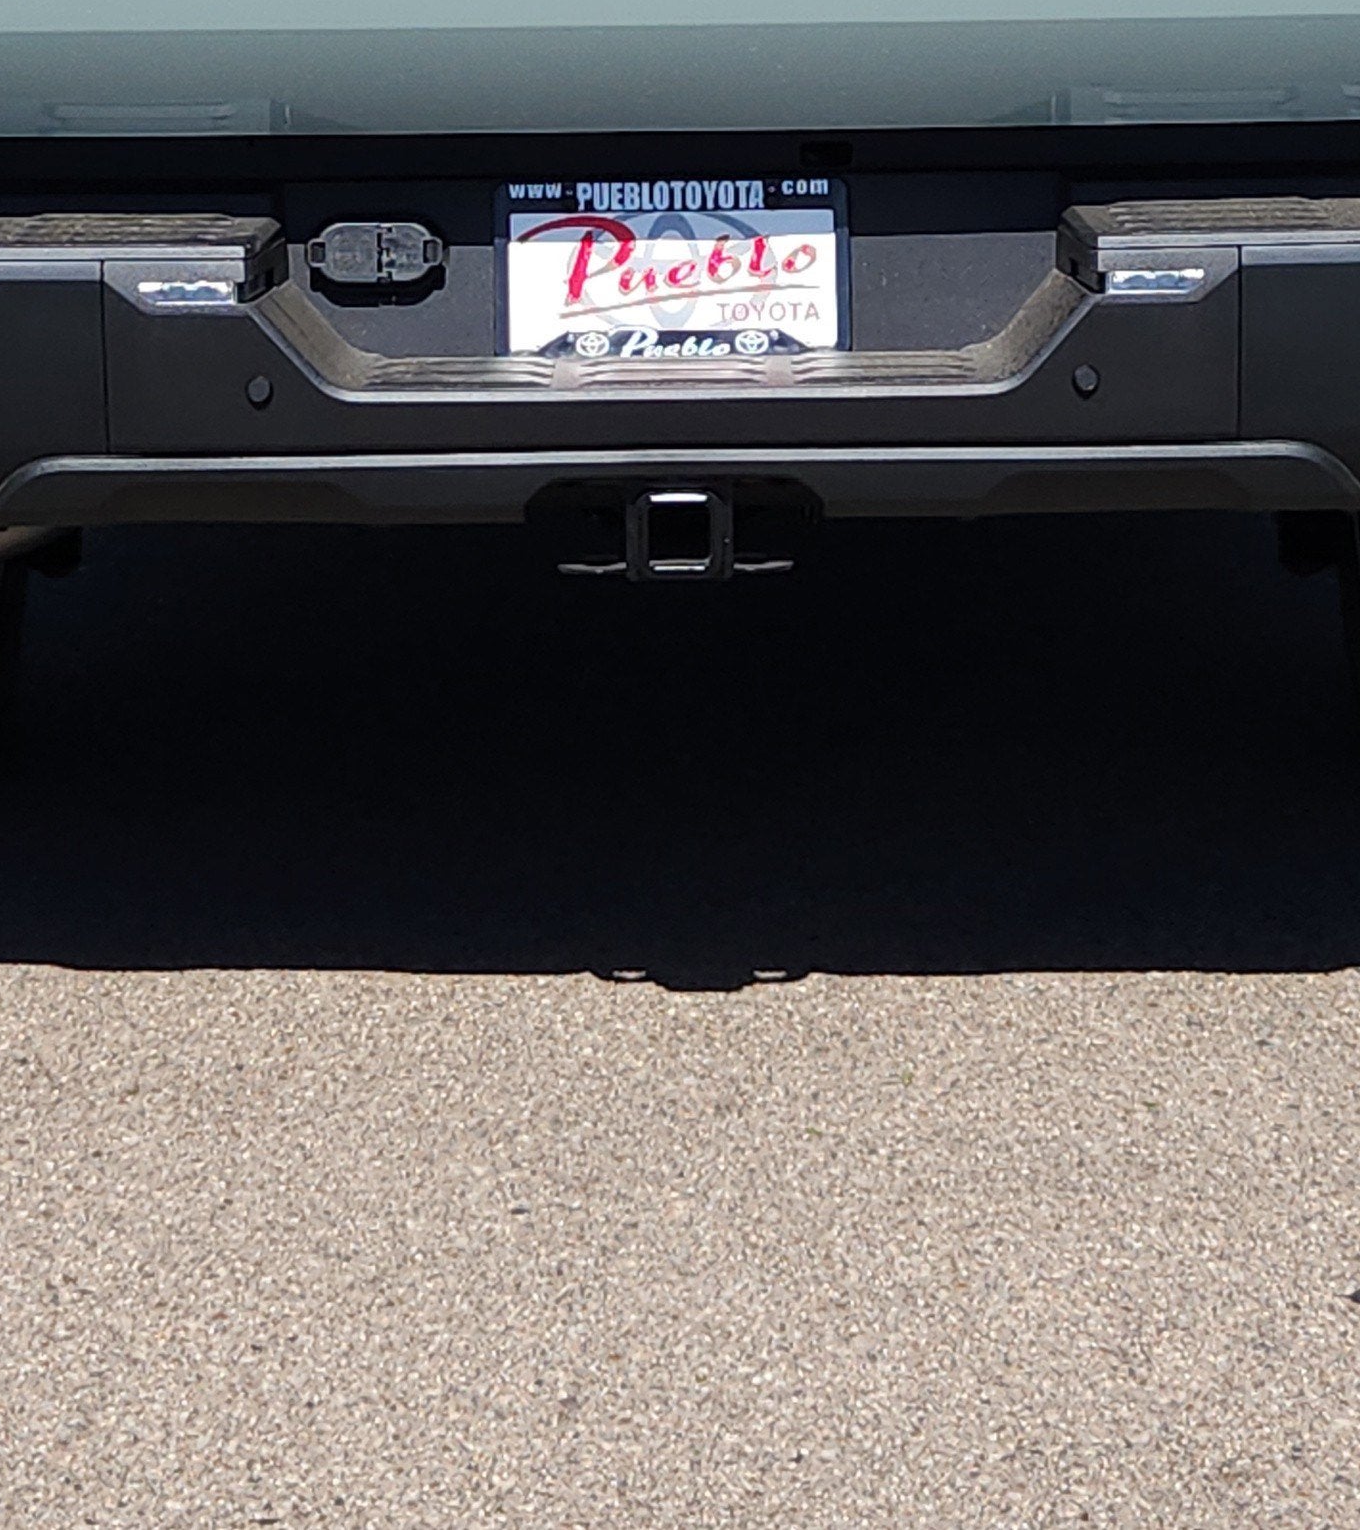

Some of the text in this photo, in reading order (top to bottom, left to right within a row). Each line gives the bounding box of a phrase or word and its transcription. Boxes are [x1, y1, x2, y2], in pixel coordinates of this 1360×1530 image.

[516, 214, 817, 307] Pueblo
[716, 301, 821, 323] TOYOTA
[607, 325, 732, 358] Pueblo
